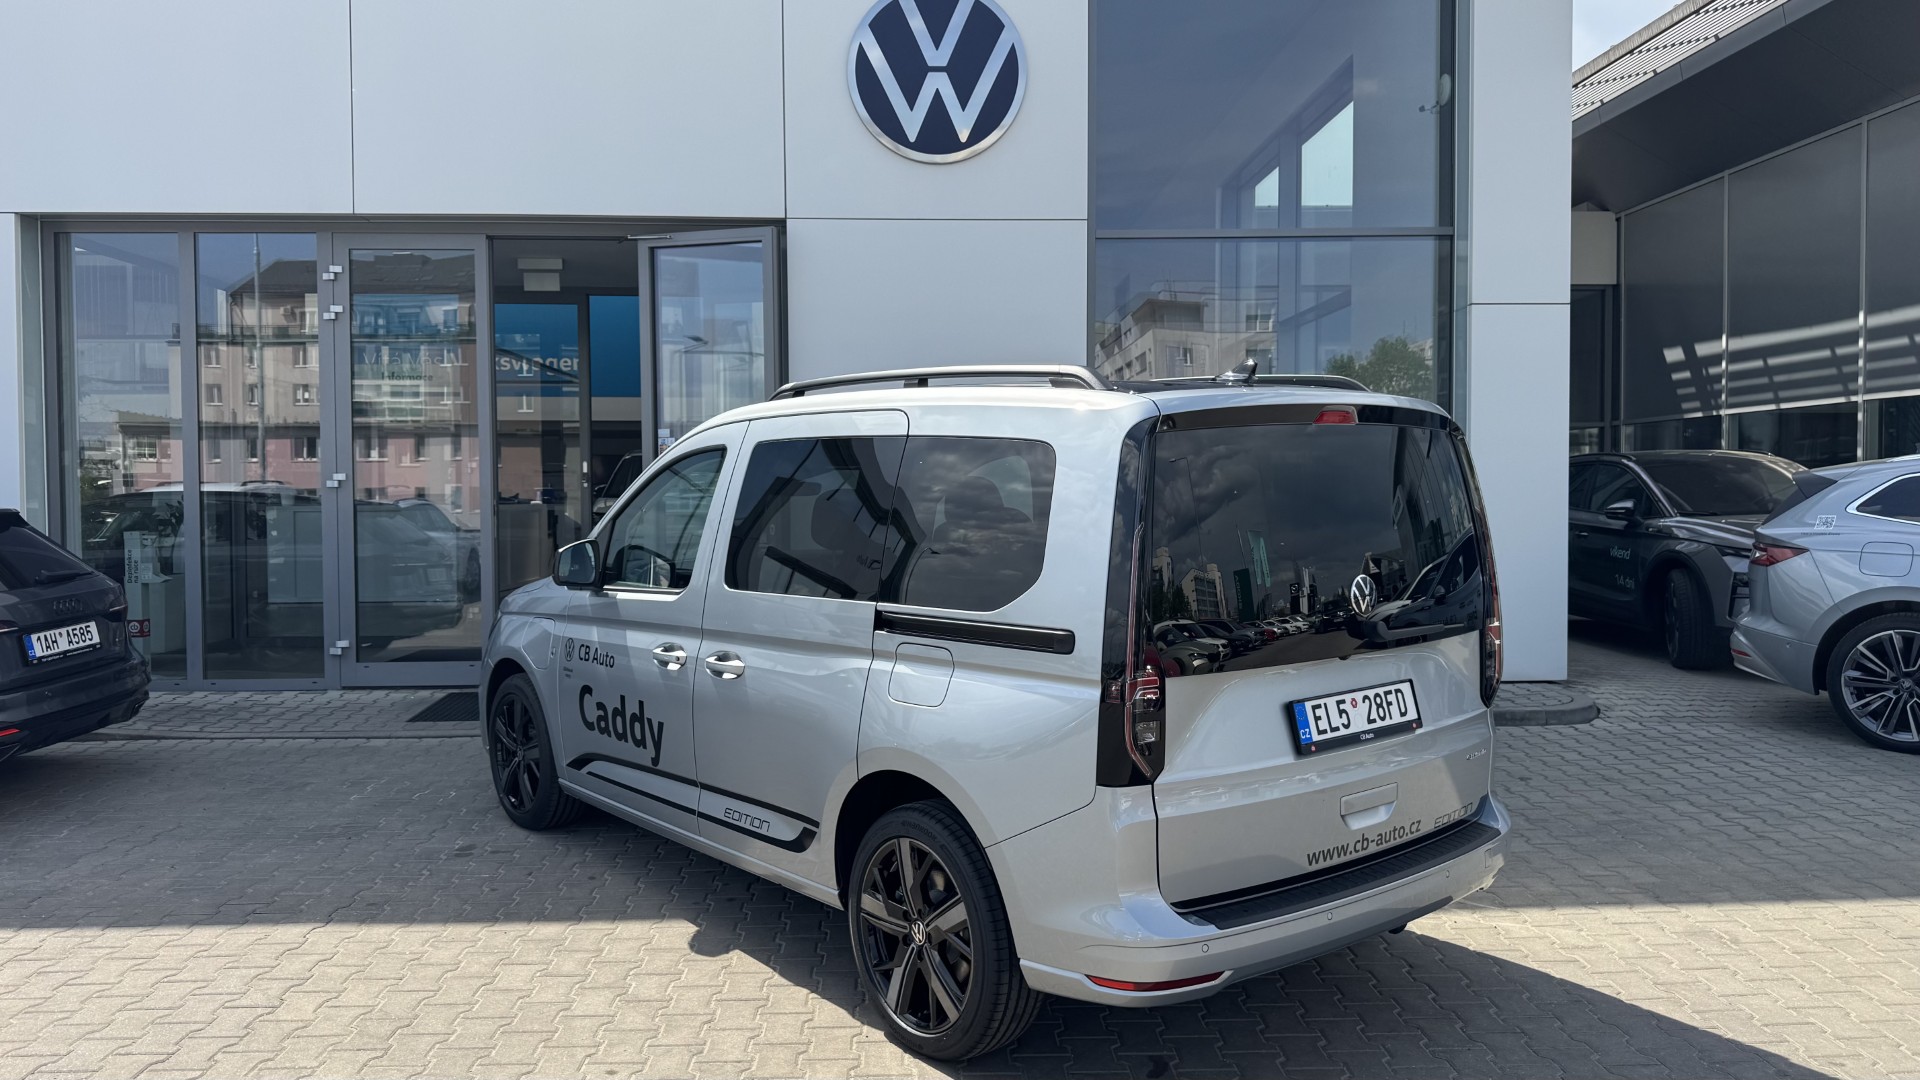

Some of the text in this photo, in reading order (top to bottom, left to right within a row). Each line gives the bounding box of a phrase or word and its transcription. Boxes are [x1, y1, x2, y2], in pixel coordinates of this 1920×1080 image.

[36, 632, 60, 654] 1AH
[65, 625, 94, 647] A585
[578, 643, 615, 668] CB Auto
[578, 684, 665, 768] Caddy
[1310, 688, 1408, 736] EL5 28FD
[1300, 728, 1311, 739] CZ
[723, 807, 771, 832] EDITION
[1433, 802, 1474, 829] EDITION
[1306, 819, 1422, 867] www.cb-auto.cz
